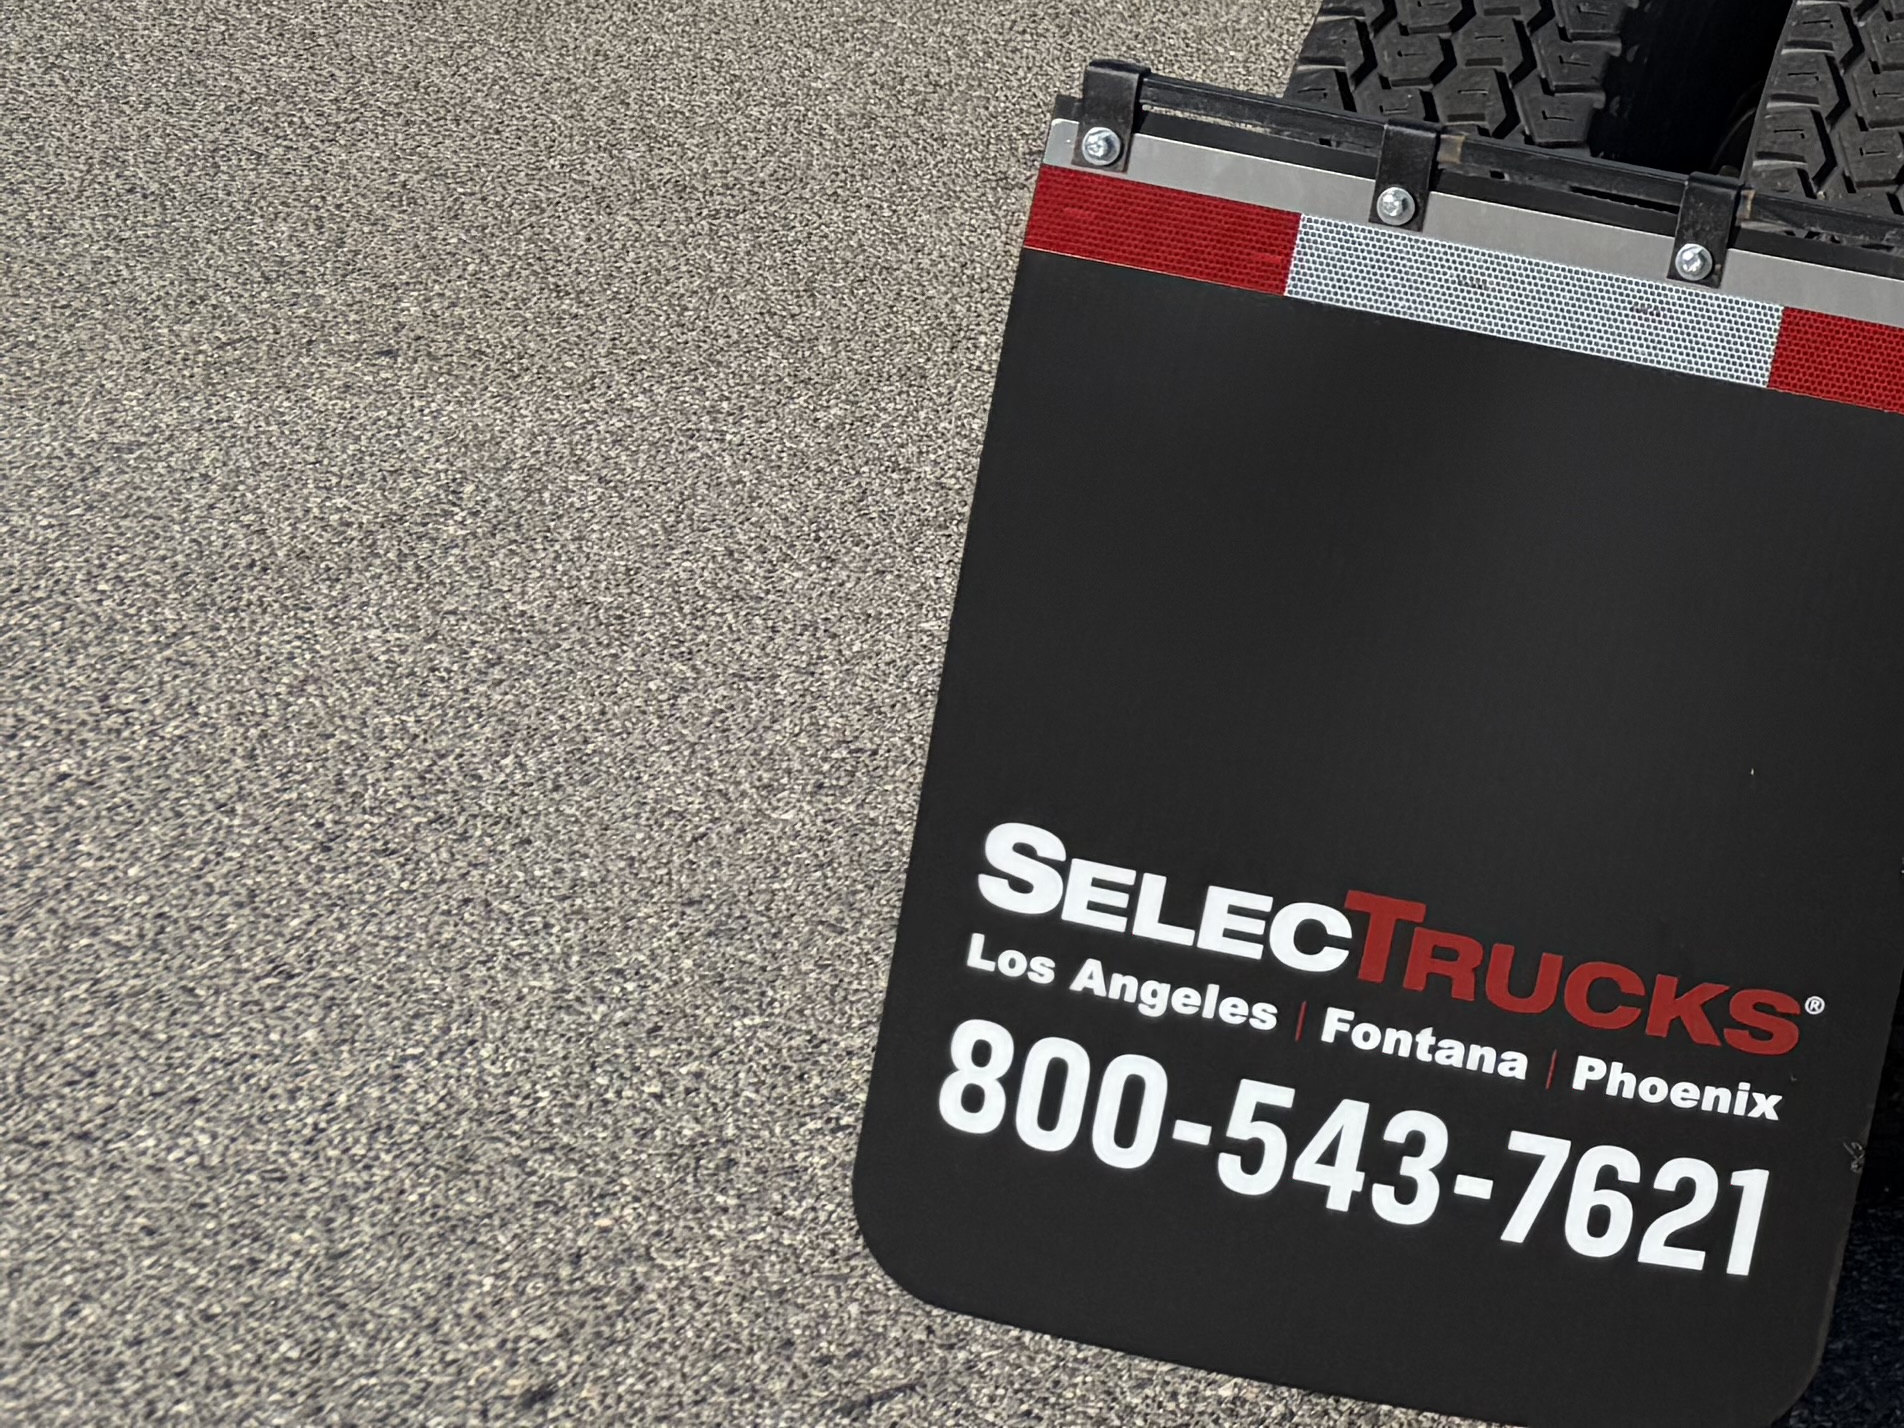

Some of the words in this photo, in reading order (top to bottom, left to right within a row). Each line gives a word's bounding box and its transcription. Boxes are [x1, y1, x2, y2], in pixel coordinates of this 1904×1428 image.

[966, 933, 1056, 985] Los
[1069, 957, 1279, 1031] Angeles
[1321, 1006, 1529, 1081] Fontana
[1572, 1054, 1783, 1121] Phoenix
[938, 1018, 1770, 1277] 800-543-7621
